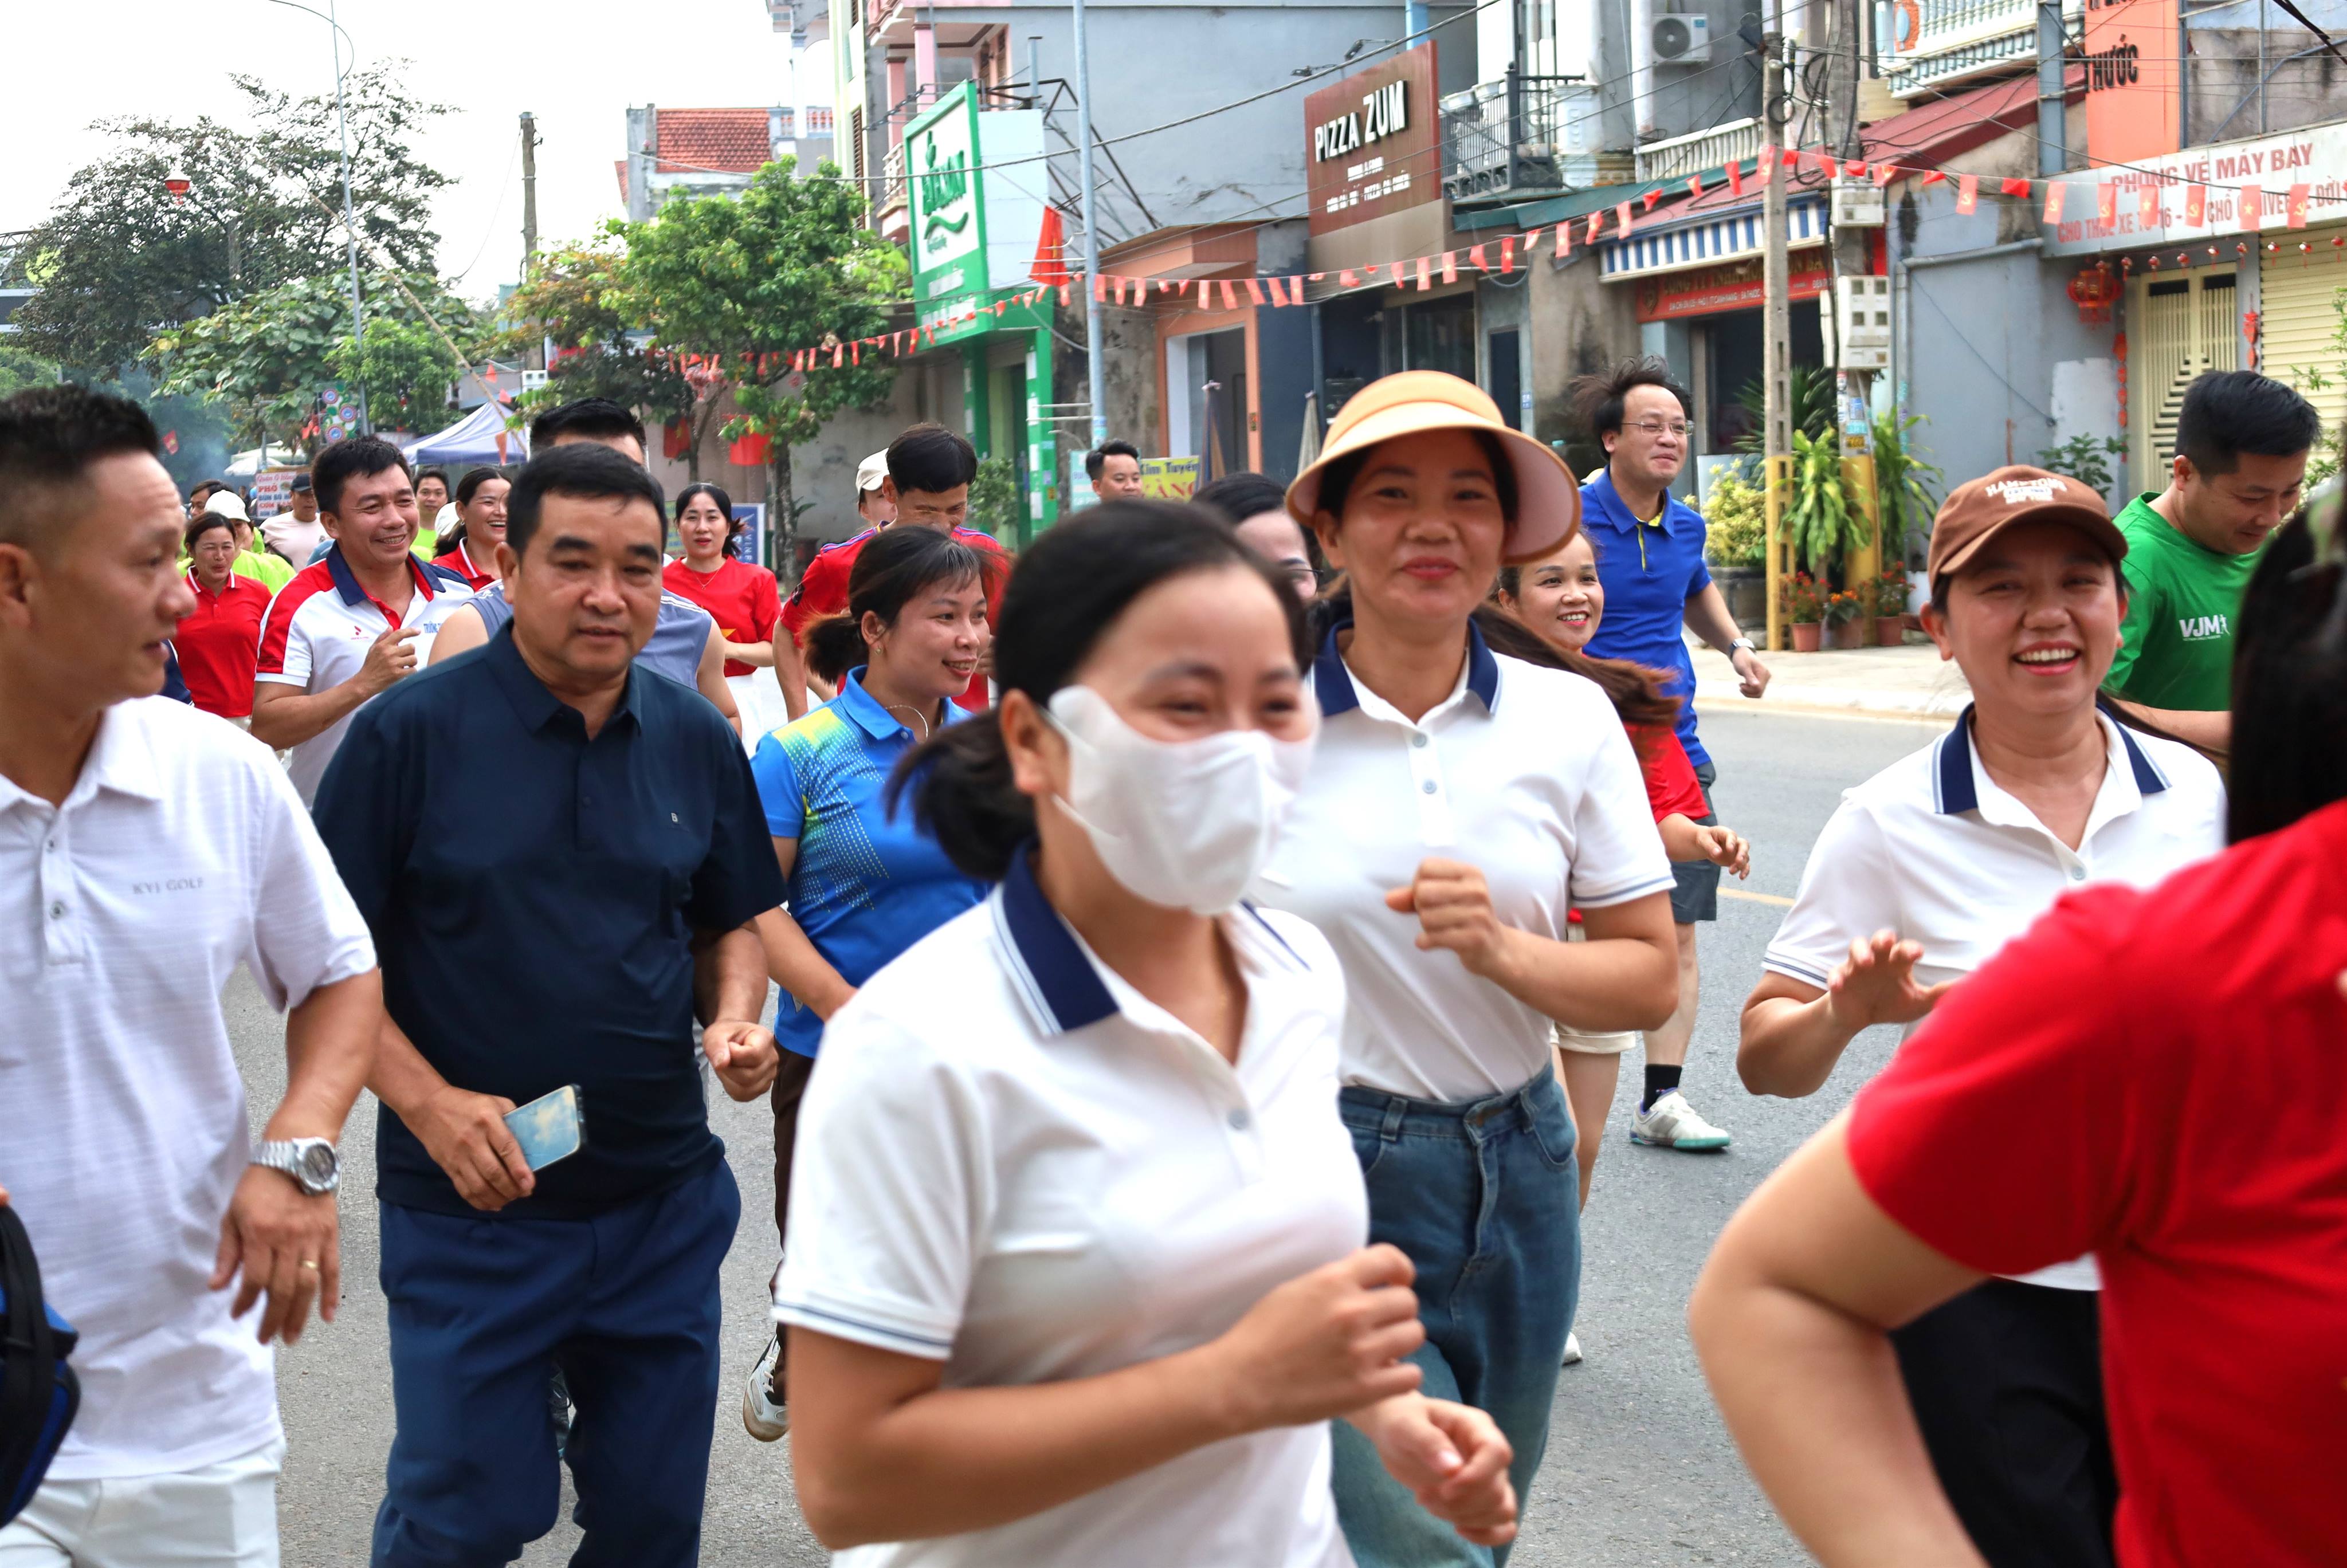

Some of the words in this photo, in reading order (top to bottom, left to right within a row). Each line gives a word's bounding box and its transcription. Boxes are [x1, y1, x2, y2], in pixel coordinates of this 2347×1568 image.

[1314, 112, 1360, 163] PIZZA
[1363, 80, 1406, 143] ZUM
[2215, 148, 2264, 179] MÁY
[2270, 143, 2313, 171] BAY
[2179, 615, 2221, 638] VJM
